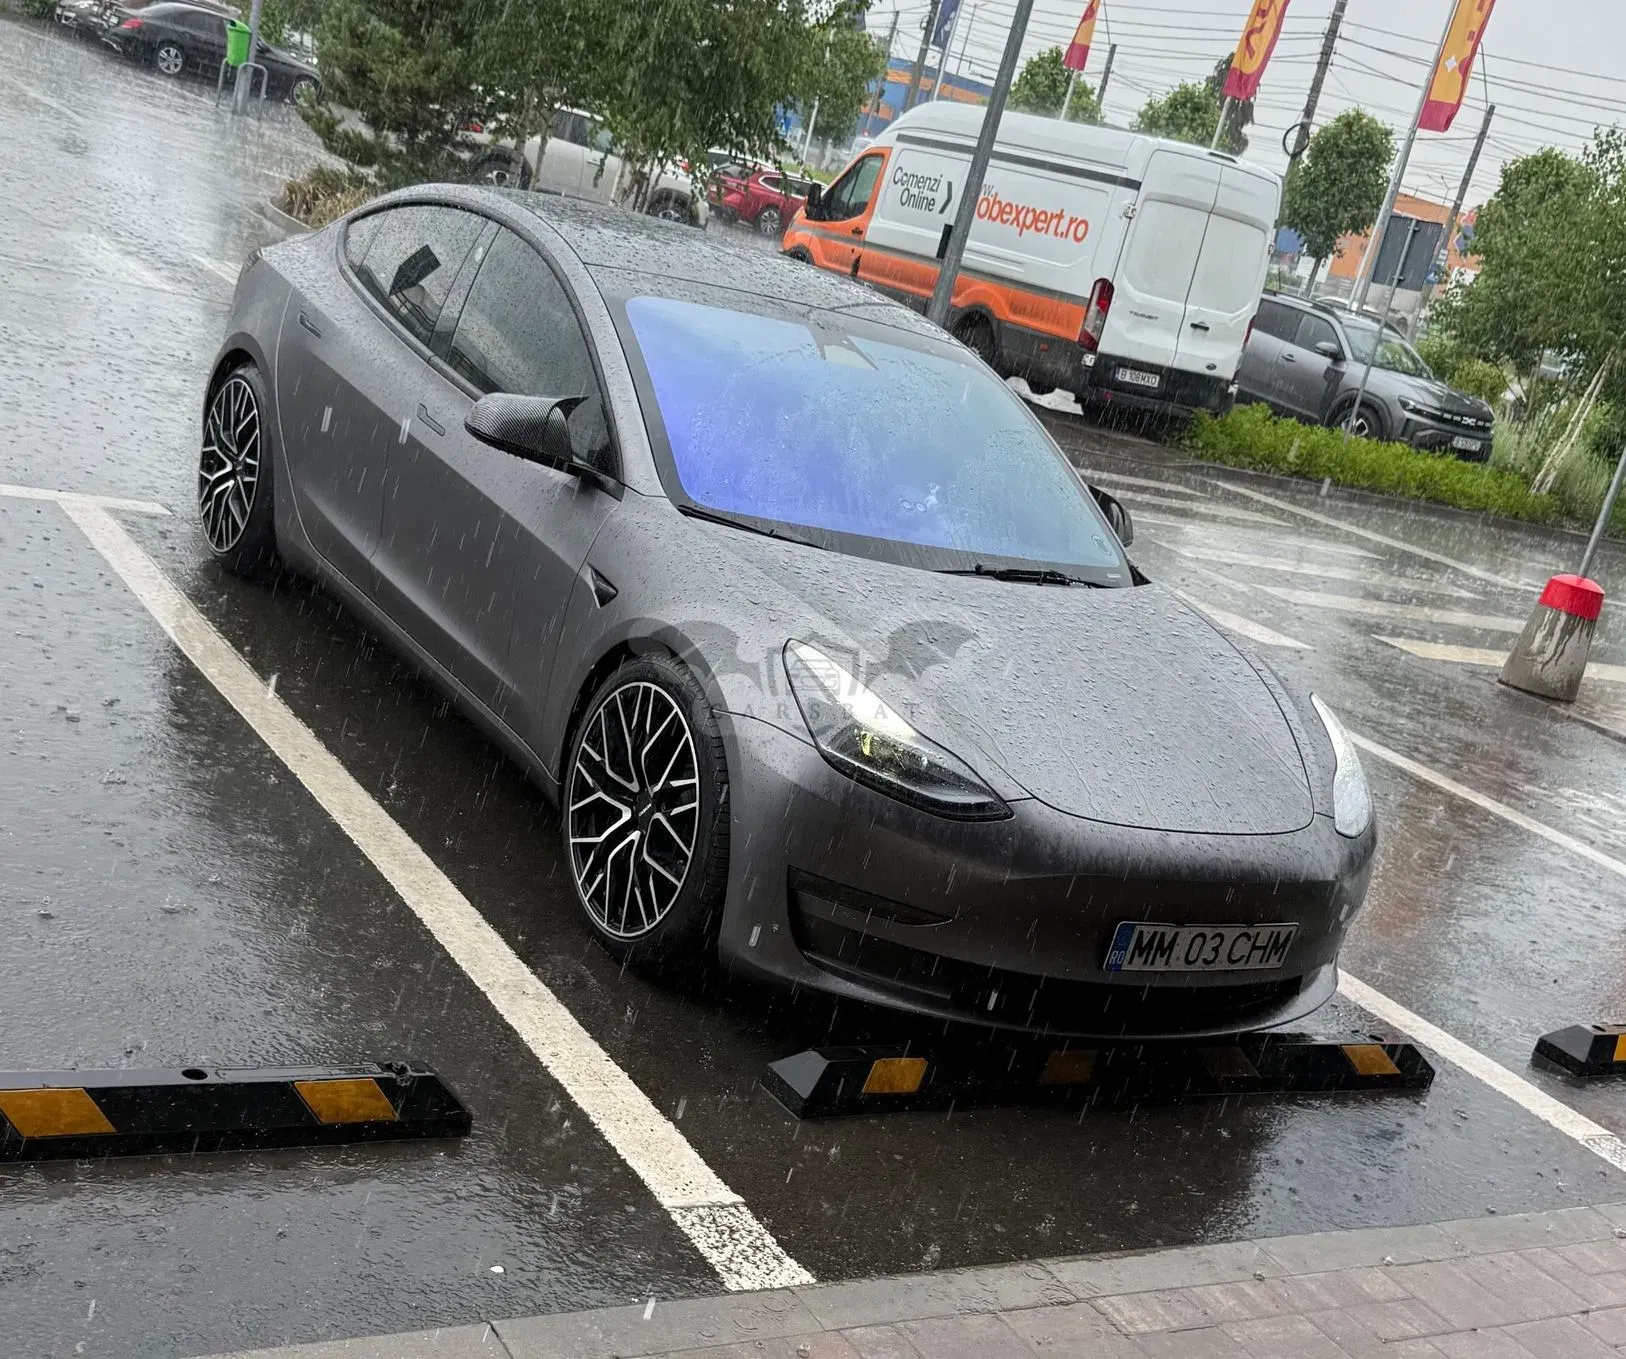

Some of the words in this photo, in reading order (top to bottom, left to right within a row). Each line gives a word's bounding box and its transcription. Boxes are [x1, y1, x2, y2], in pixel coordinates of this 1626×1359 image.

[893, 166, 943, 193] Comenzi
[900, 187, 936, 213] Online
[976, 192, 1089, 243] obexpert.ro
[1108, 950, 1126, 965] RO
[1127, 930, 1179, 965] MM
[1184, 932, 1225, 965] 03
[1227, 930, 1293, 965] CHM
